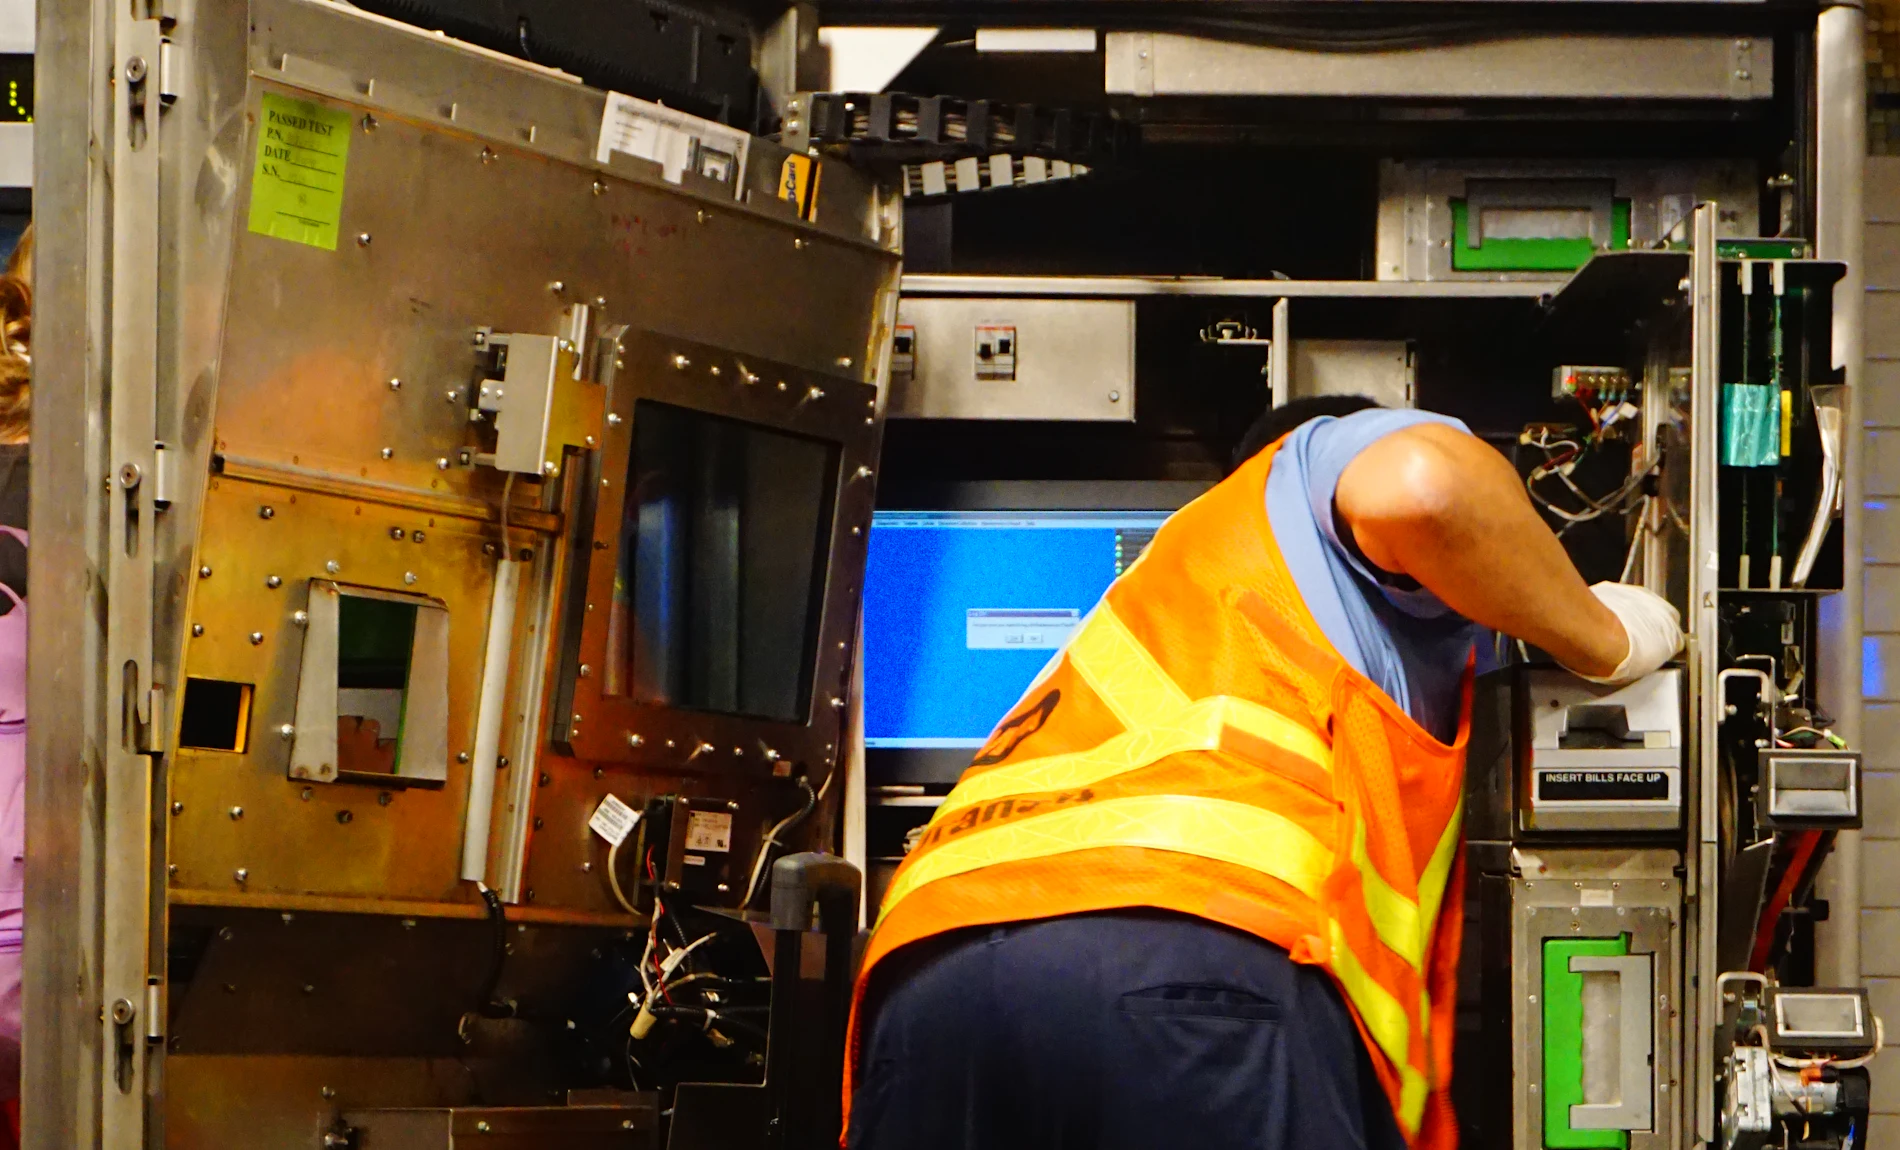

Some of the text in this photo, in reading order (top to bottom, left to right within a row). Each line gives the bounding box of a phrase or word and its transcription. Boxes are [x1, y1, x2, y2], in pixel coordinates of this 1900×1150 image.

[269, 110, 335, 137] PASSED TEST
[266, 127, 284, 142] P.N.
[264, 144, 292, 162] DATE
[1545, 773, 1661, 783] INSERT BILLS FACE UP
